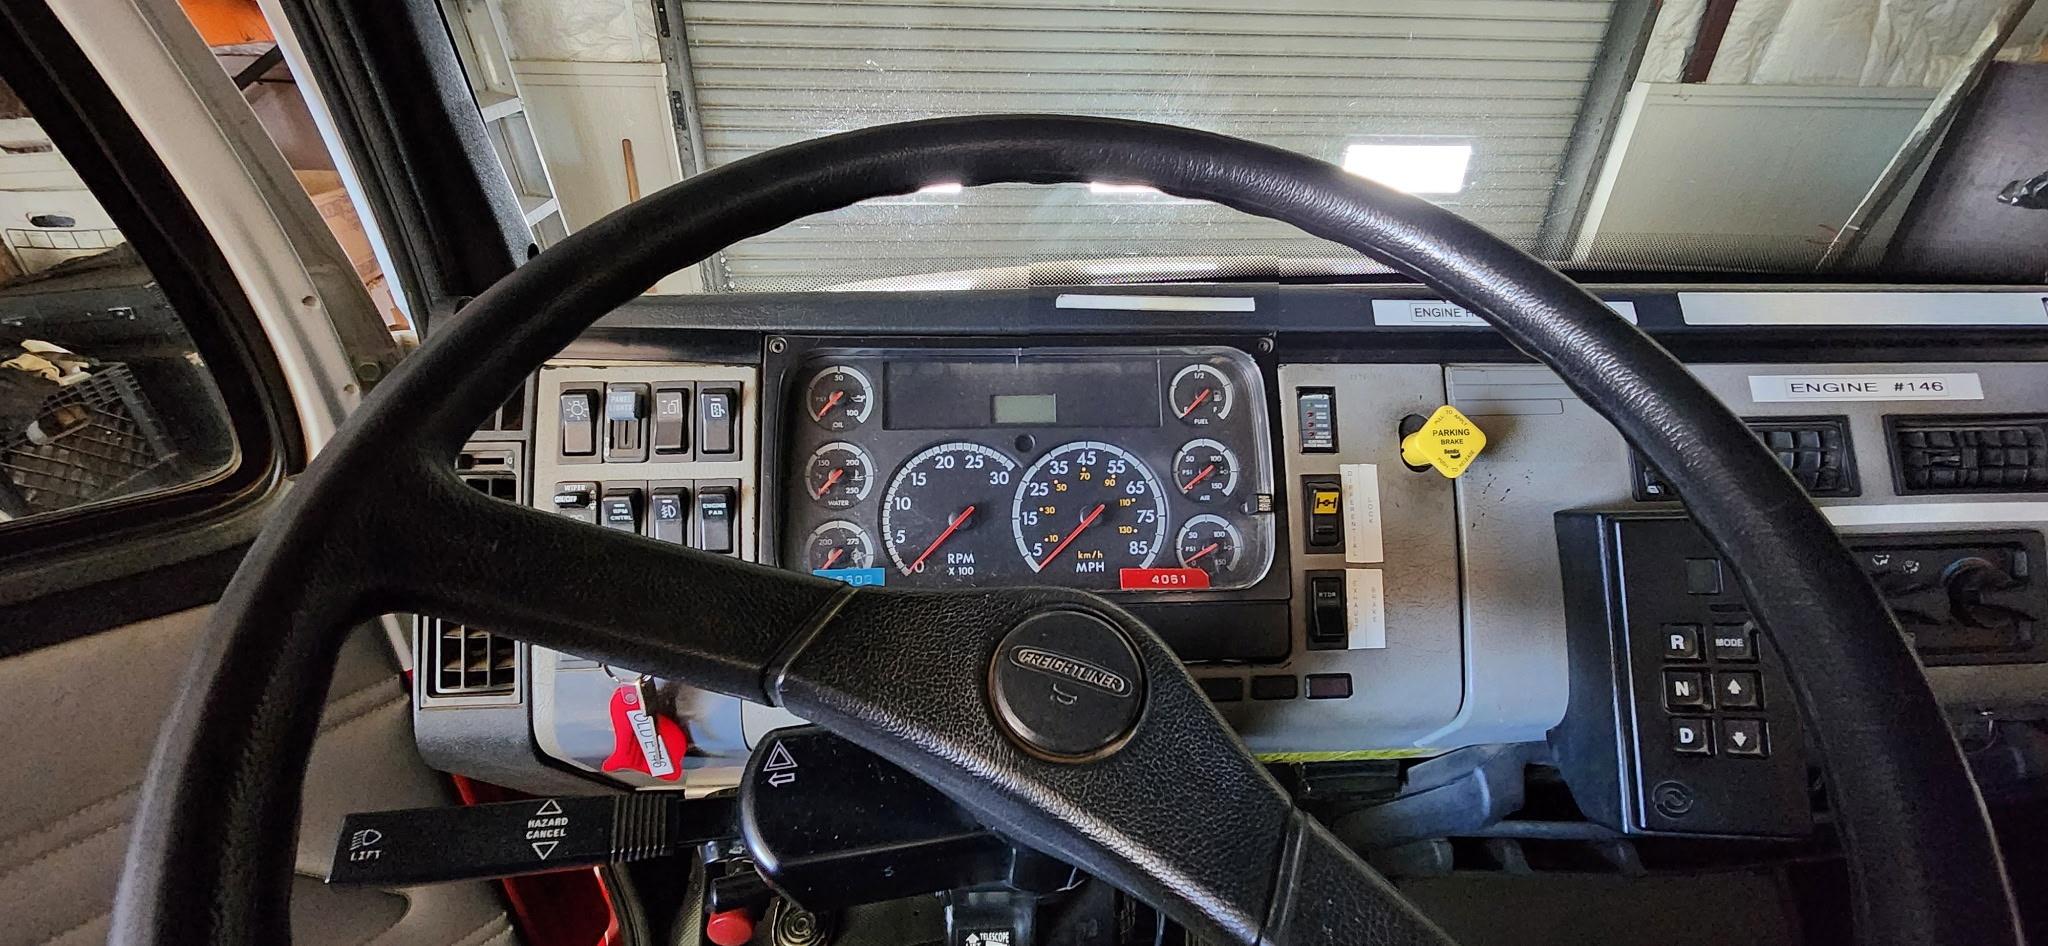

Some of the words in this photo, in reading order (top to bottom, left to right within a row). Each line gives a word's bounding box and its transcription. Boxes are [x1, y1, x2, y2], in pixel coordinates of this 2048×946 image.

[1414, 307, 1461, 318] ENGINE
[1790, 382, 1879, 393] ENGINE
[1894, 381, 1944, 392] #146
[1432, 428, 1470, 436] PARKING
[935, 455, 955, 469] 20
[965, 455, 984, 469] 25
[1076, 451, 1096, 465] 45
[1049, 460, 1069, 475] 35
[1107, 460, 1126, 474] 55
[911, 472, 927, 486] 15
[989, 471, 1009, 485] 30
[1079, 472, 1091, 480] 70
[1030, 482, 1049, 496] 25
[1056, 484, 1067, 492] 50
[1104, 479, 1116, 487] 90
[1126, 480, 1145, 495] 65
[554, 495, 578, 503] ON/OFF
[894, 497, 912, 510] 10
[1119, 498, 1131, 507] 110
[1044, 506, 1056, 514] 30
[1022, 511, 1038, 526] 15
[1136, 509, 1155, 524] 75
[1118, 526, 1133, 534] 130
[1187, 531, 1198, 539] 50
[1213, 530, 1226, 538] 100
[818, 538, 833, 546] 200
[895, 530, 906, 543] 5
[1049, 535, 1059, 543] 10
[1032, 542, 1043, 557] 5
[1129, 540, 1148, 555] 85
[947, 553, 975, 564] RPM
[1077, 550, 1103, 560] km/h
[914, 559, 925, 573] 0
[948, 567, 955, 576] X
[958, 566, 975, 576] 100
[1075, 561, 1105, 573] MPH
[1151, 574, 1187, 584] 4061
[1670, 634, 1685, 650] R
[1715, 638, 1744, 648] MODE
[1018, 650, 1125, 692] FREIGHTLINER
[1675, 681, 1690, 697] N
[1680, 727, 1694, 744] D
[527, 817, 569, 829] HAZARD
[525, 828, 568, 840] CANCEL
[350, 850, 382, 862] LIFT
[979, 931, 1010, 944] TELESCOPE
